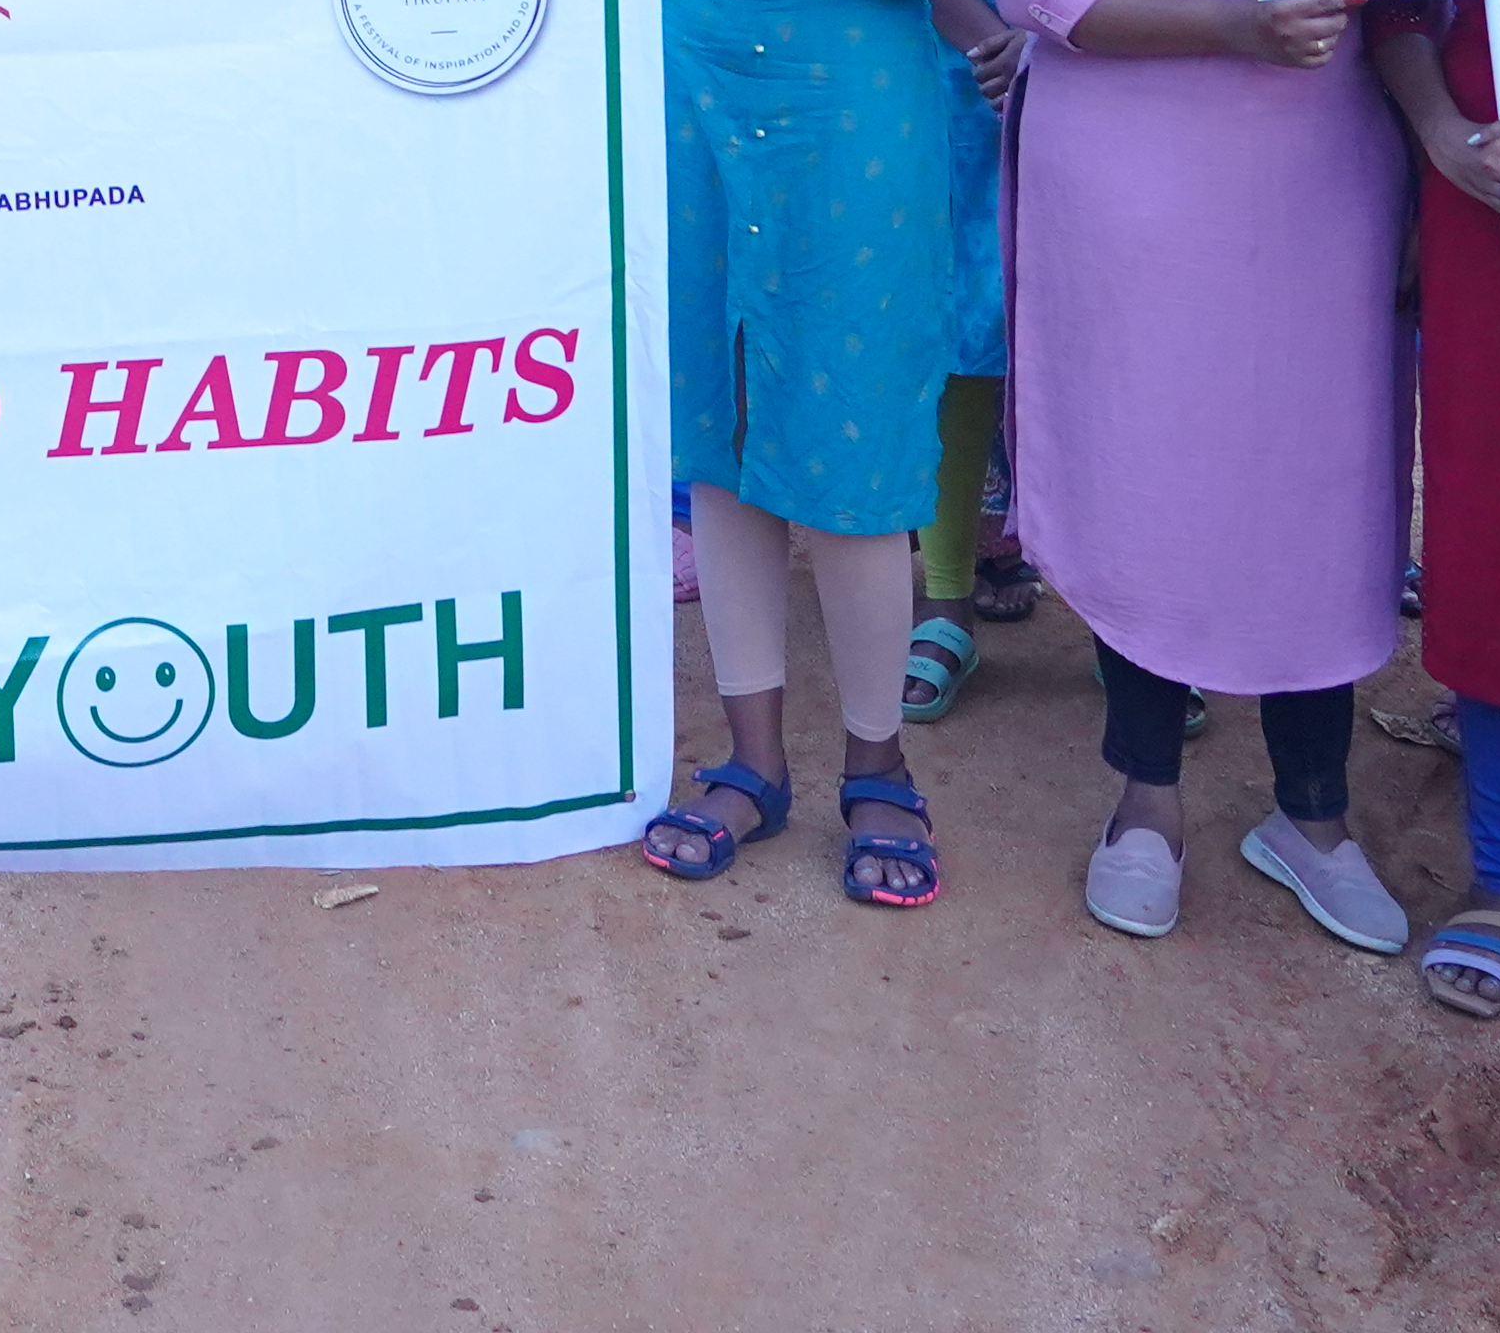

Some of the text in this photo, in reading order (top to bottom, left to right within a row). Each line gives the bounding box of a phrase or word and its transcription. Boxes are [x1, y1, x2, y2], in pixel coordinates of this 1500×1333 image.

[354, 3, 362, 12] A
[359, 14, 400, 60] FESTIVAL
[404, 55, 420, 66] OF
[425, 42, 501, 71] INSPIRATION
[502, 19, 521, 44] AND
[46, 328, 579, 458] HABITS
